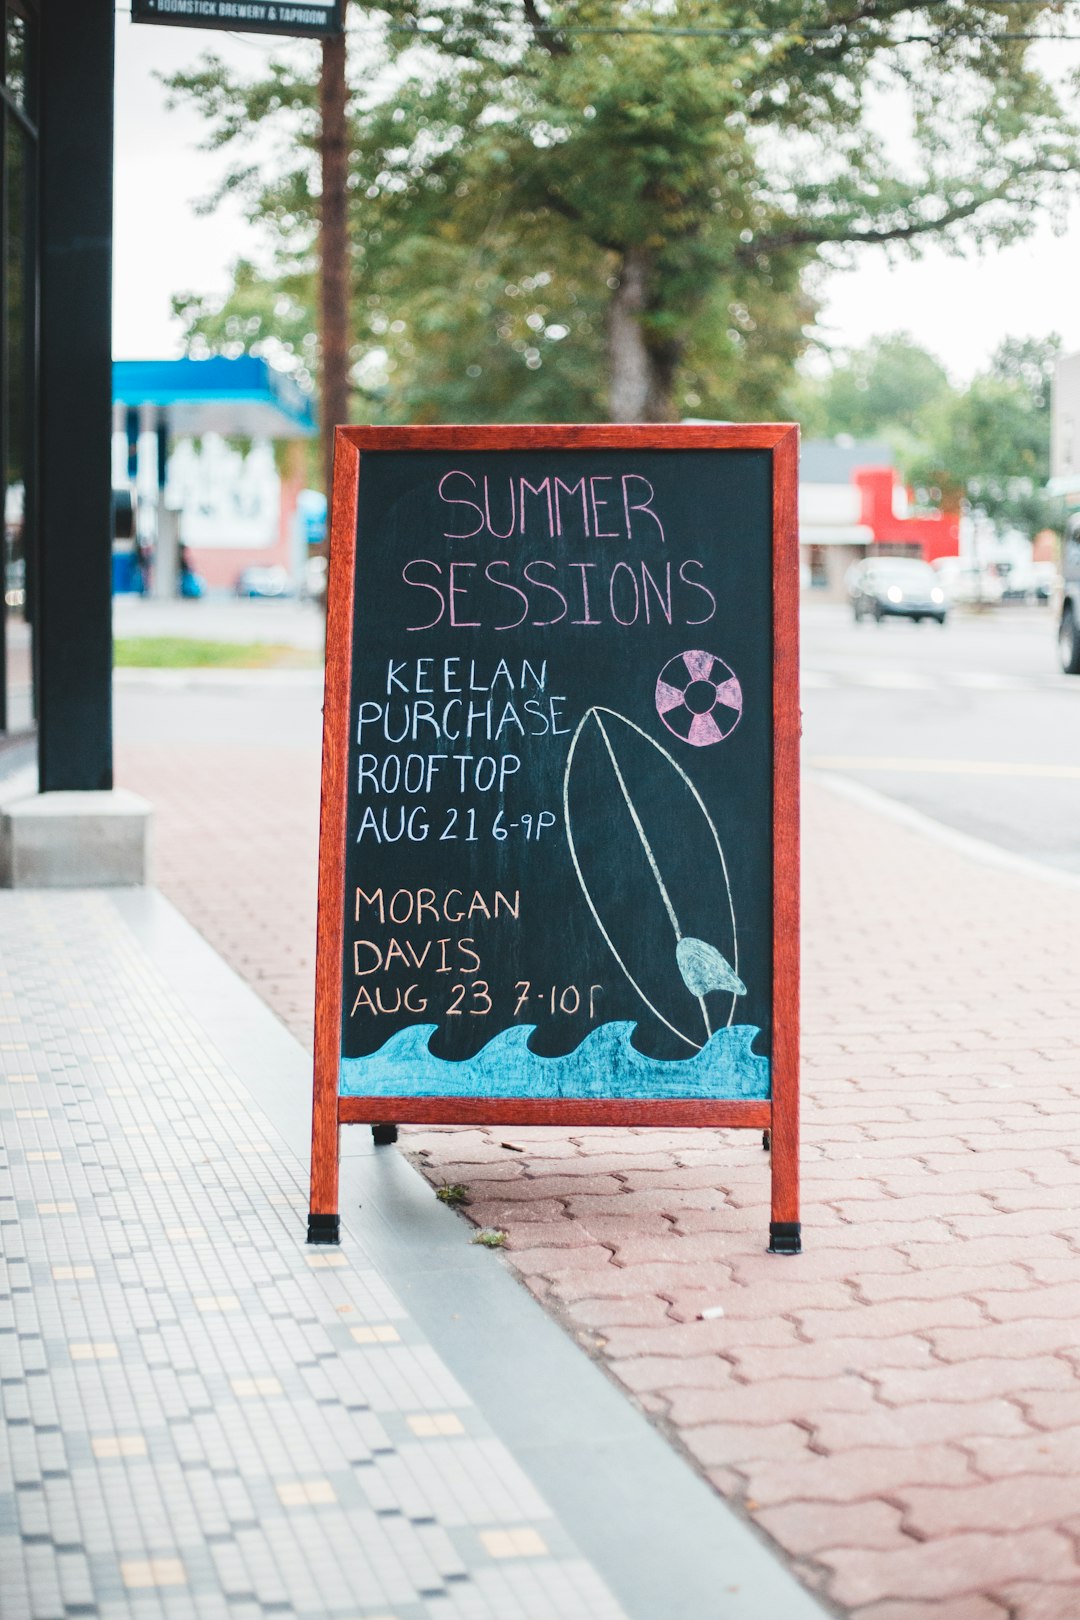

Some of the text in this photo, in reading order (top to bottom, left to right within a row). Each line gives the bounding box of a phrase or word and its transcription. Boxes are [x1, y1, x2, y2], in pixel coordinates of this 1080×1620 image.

[157, 0, 327, 24] BOOMSTICK BREWERY & TAPROOM
[438, 470, 666, 543] SUMMER
[402, 559, 717, 631] SESSIONS
[386, 657, 548, 696] KEELAN
[357, 697, 572, 746] PURCHASE
[357, 754, 522, 795] ROOFTOP
[356, 806, 556, 844] AUG 21 6-9P
[354, 887, 521, 925] MORGAN
[353, 937, 482, 976] DAVIS
[350, 982, 429, 1018] AUG
[446, 980, 493, 1016] 23
